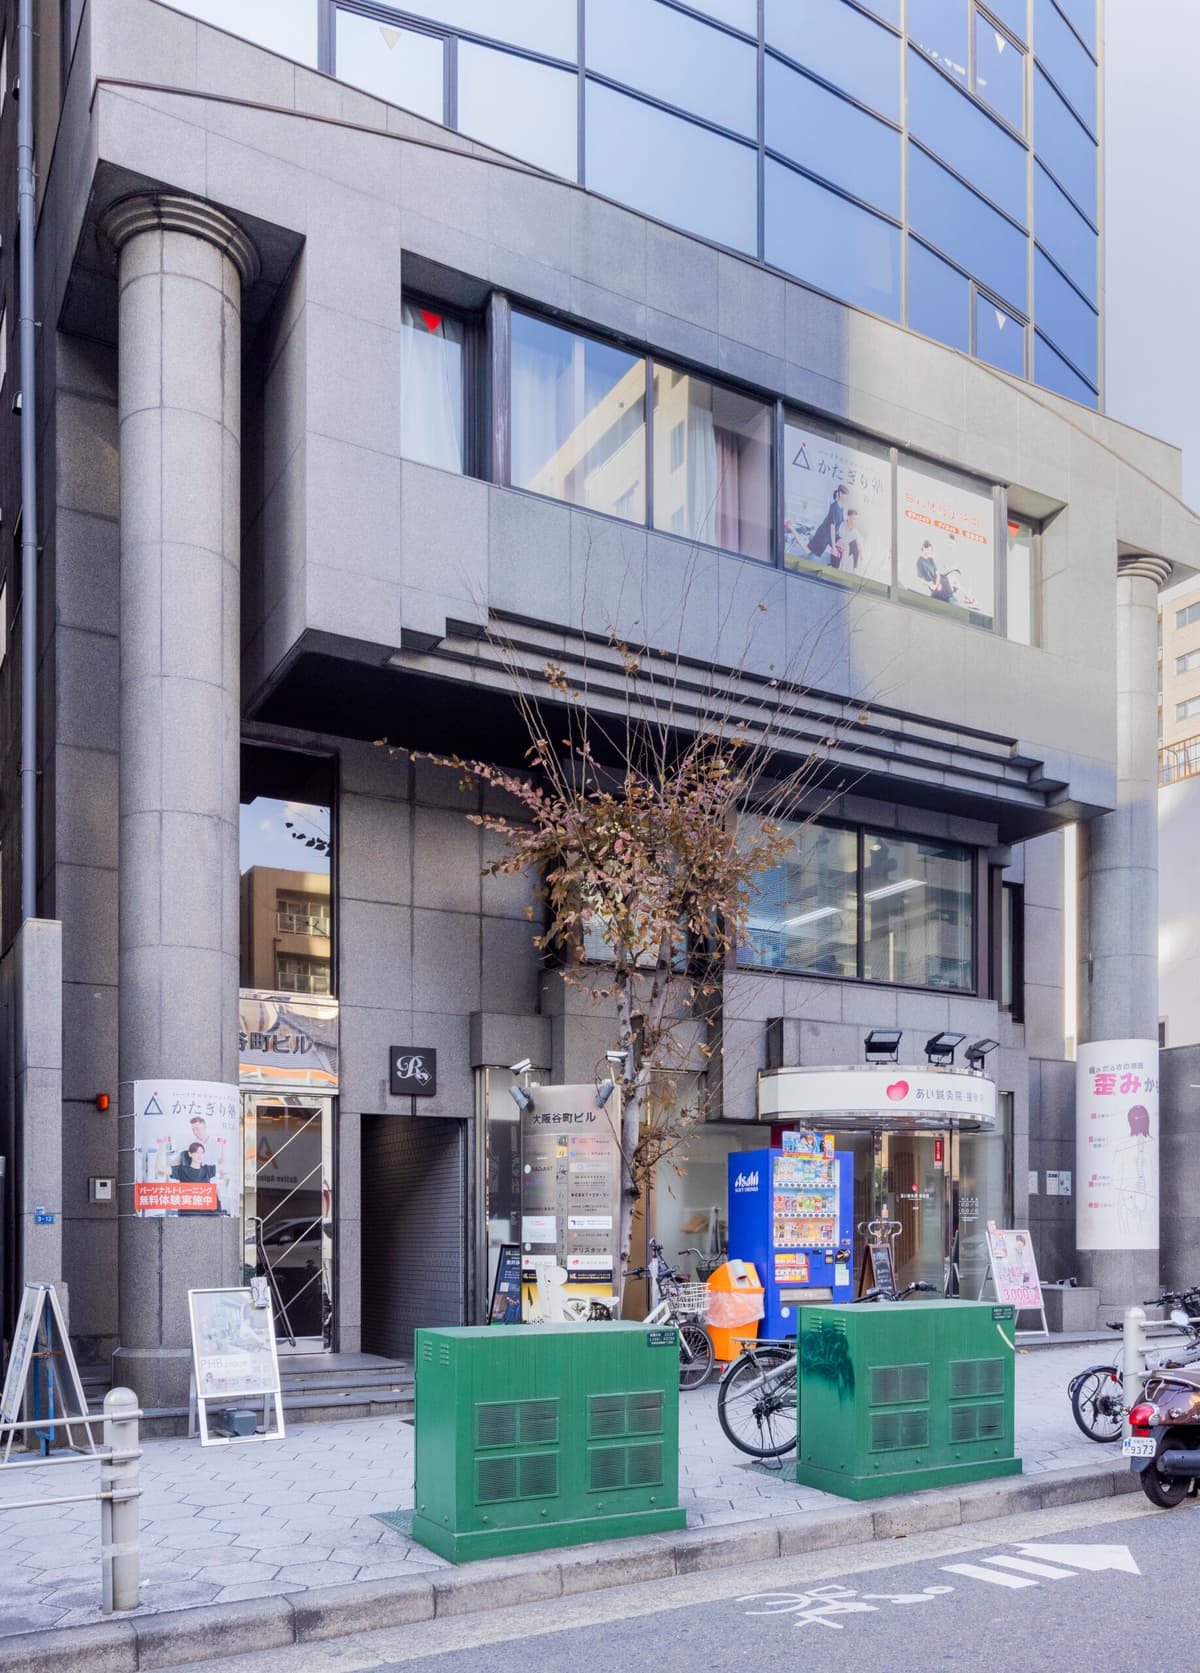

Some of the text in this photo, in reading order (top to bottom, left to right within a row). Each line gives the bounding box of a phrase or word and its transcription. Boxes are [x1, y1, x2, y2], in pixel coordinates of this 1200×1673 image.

[532, 1112, 596, 1125] 大阪谷町ビル
[735, 1170, 759, 1187] Asahi
[140, 1187, 212, 1195] パーソナルトレーニング
[140, 1195, 212, 1206] 無料体験実施中
[1130, 1444, 1154, 1455] 9373
